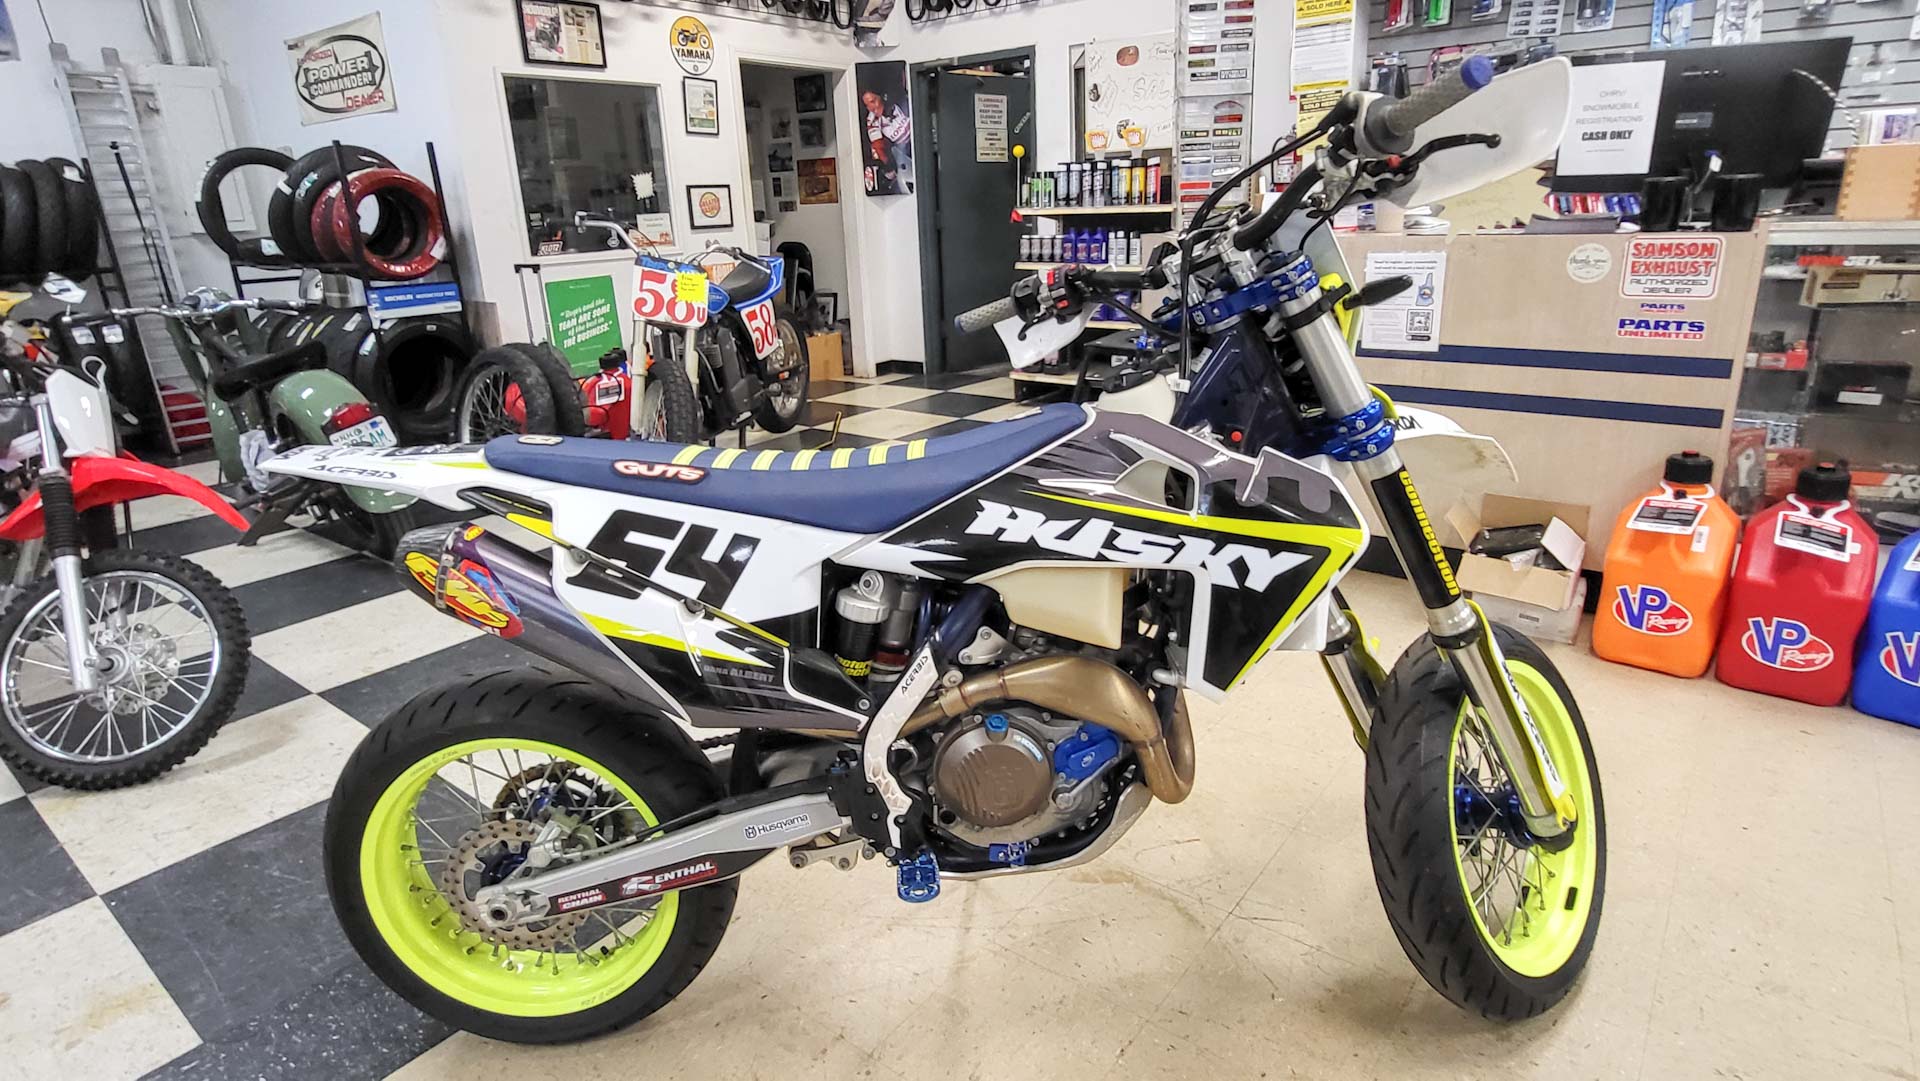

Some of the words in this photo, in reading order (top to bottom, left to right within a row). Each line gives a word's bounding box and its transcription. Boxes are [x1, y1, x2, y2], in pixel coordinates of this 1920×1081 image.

[674, 47, 712, 61] YAMAHA
[306, 56, 370, 84] POWER
[345, 89, 386, 111] DEALER
[1582, 102, 1640, 112] SNOWMOBILE
[1575, 115, 1644, 125] REGISTRATIONS
[1581, 131, 1608, 141] CASH
[1609, 129, 1634, 140] ONLY
[1631, 242, 1717, 259] SAMSON
[1630, 260, 1717, 276] EXHAUST
[1629, 278, 1709, 286] AUTHORIZED
[1642, 286, 1692, 294] DEALER
[1640, 302, 1685, 310] PARTS
[559, 317, 577, 332] TEAM
[578, 311, 591, 324] ARE
[592, 303, 611, 318] SOME
[1618, 318, 1705, 332] PARTS
[745, 303, 777, 355] 58
[1617, 329, 1704, 340] UNLIMITED
[563, 335, 576, 348] THE
[308, 464, 397, 479] ACERBIS
[613, 460, 705, 481] GUTS
[964, 498, 1314, 593] HUSKY
[566, 509, 762, 621] 54
[1618, 585, 1668, 630] VP
[1648, 614, 1690, 631] Racing
[1748, 618, 1808, 665] VP
[1782, 648, 1832, 665] Racing
[729, 667, 775, 683] ALBERT
[901, 655, 929, 695] ACERBIS
[757, 814, 809, 834] Husqvarna
[558, 888, 600, 904] RENTHAL
[562, 894, 603, 910] CHAIN
